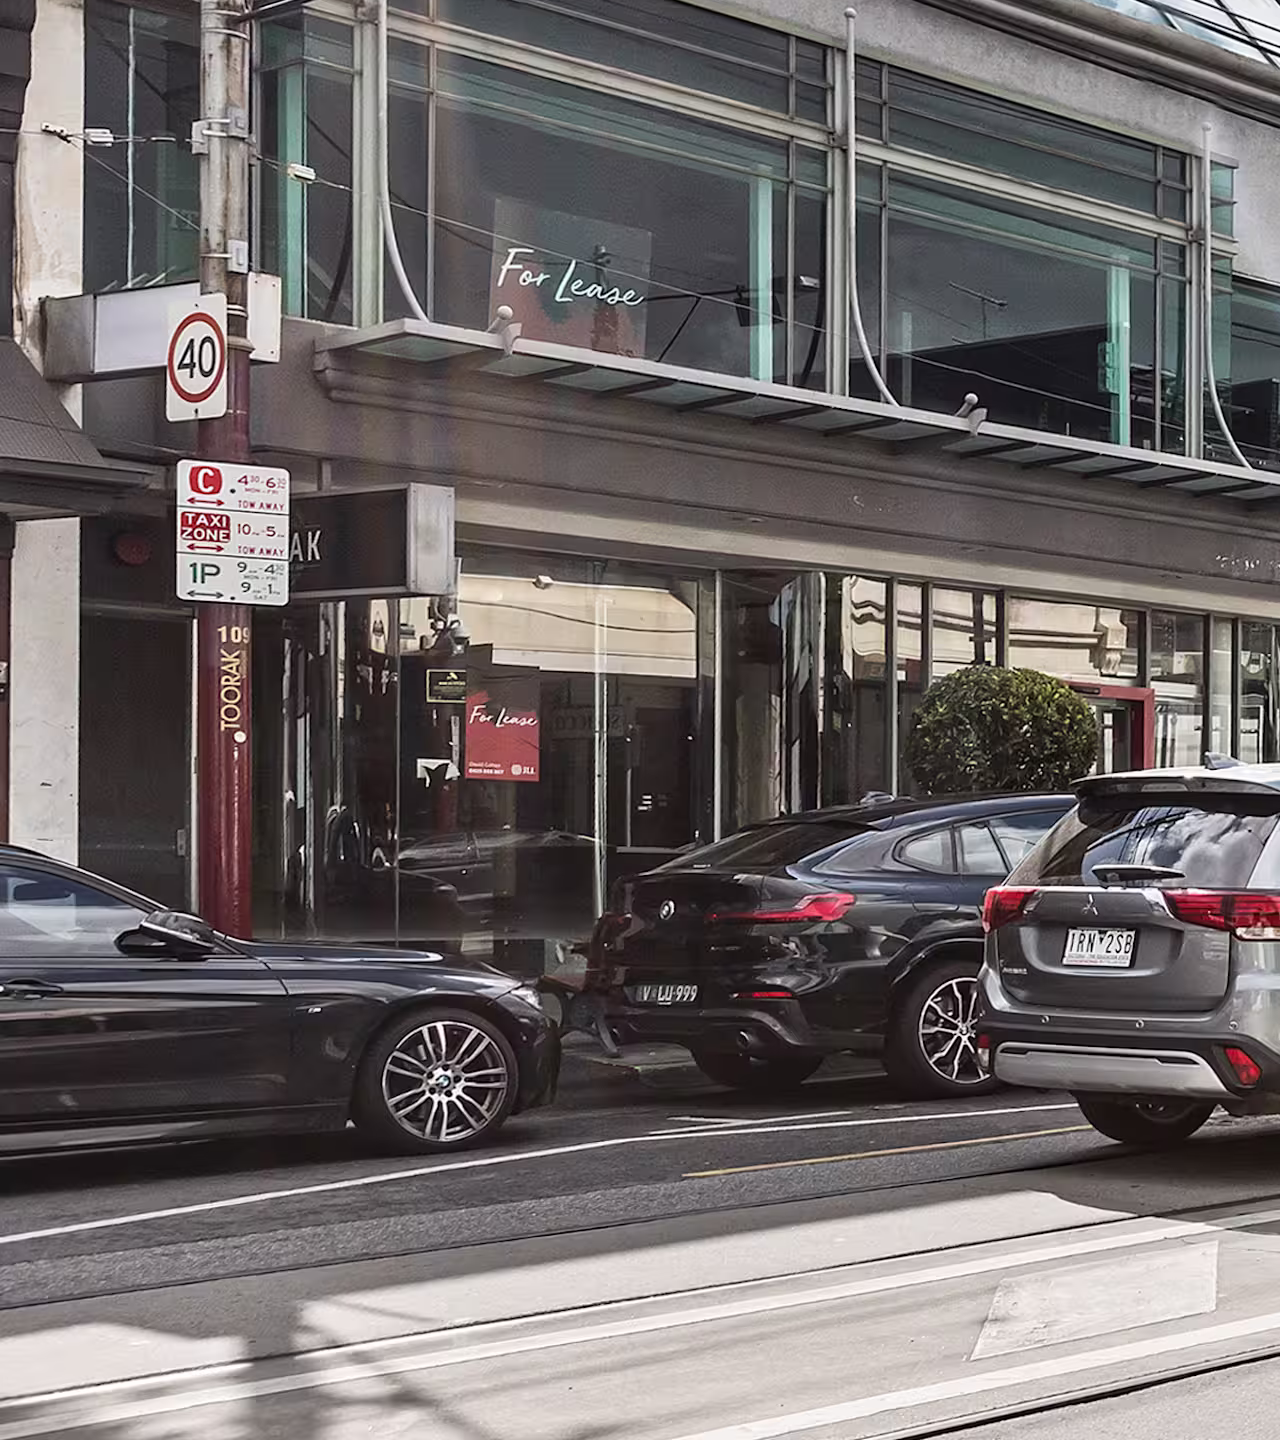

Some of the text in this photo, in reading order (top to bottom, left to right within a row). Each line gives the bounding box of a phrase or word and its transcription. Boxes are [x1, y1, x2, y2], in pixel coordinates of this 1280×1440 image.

[497, 248, 645, 306] For Lease
[177, 335, 217, 379] 40
[197, 467, 215, 493] C
[238, 499, 285, 512] TOW AWAY
[184, 512, 227, 528] TAXI
[181, 527, 230, 542] ZONE
[238, 545, 285, 558] TOW AWAY
[189, 561, 221, 585] 1P
[220, 648, 242, 732] TOORAK
[469, 705, 494, 725] For
[495, 707, 539, 728] Lease
[1105, 933, 1132, 954] 2SB
